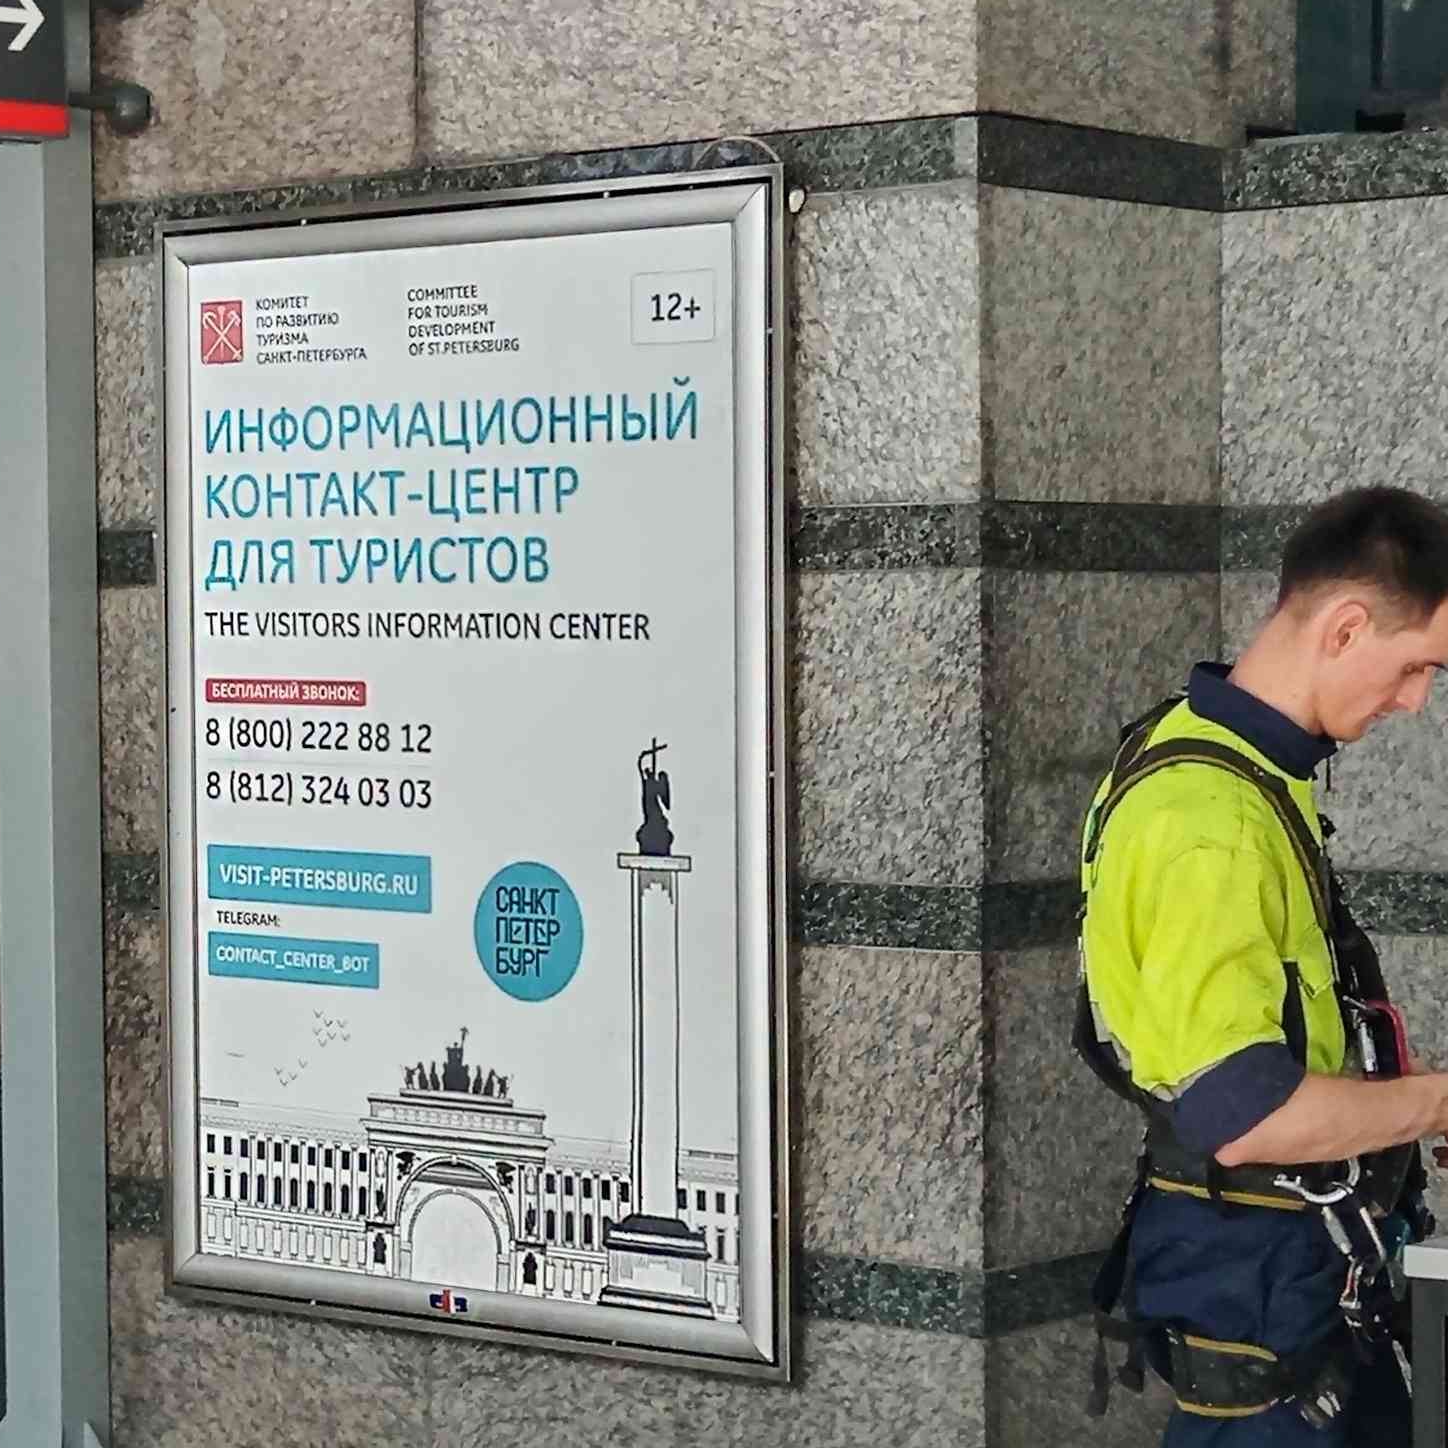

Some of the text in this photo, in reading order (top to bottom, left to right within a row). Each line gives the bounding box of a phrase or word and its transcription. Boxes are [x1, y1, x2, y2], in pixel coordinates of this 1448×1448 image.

[256, 296, 308, 311] КОМИТЕТ
[407, 284, 479, 302] COMMITTEE
[256, 312, 339, 328] ПО РАЗВИТИЮ
[408, 303, 489, 320] FOR TOURISM
[650, 292, 702, 323] 12+
[256, 332, 309, 347] ТУРИЗМА
[408, 320, 496, 338] DEVELOPMENT
[256, 347, 367, 365] САНКТ-ПЕТЕРБУРГА
[408, 343, 426, 357] OF
[205, 376, 698, 453] ИНФОРМАЦИОННЫЙ
[205, 465, 580, 522] КОНТАКТ-ЦЕНТР
[204, 535, 550, 592] ДЛЯ ТУРИСТОВ
[205, 611, 650, 641] THE VISITORS INFORMATION CENTER
[211, 681, 359, 702] БЕСПЛАТНЫЙ ЗВОНОК:
[205, 717, 432, 754] 8 (800) 222 88 12
[205, 771, 432, 808] 8 (812) 324 03 03
[219, 865, 418, 896] VISIT-PETERSBURG.RU
[495, 886, 561, 916] САНКТ
[216, 910, 280, 927] TELEGRAM:
[495, 917, 561, 946] ПЕТЕР
[216, 946, 370, 974] CONTACT_CENTER_BOT
[495, 946, 549, 977] БУРГ
